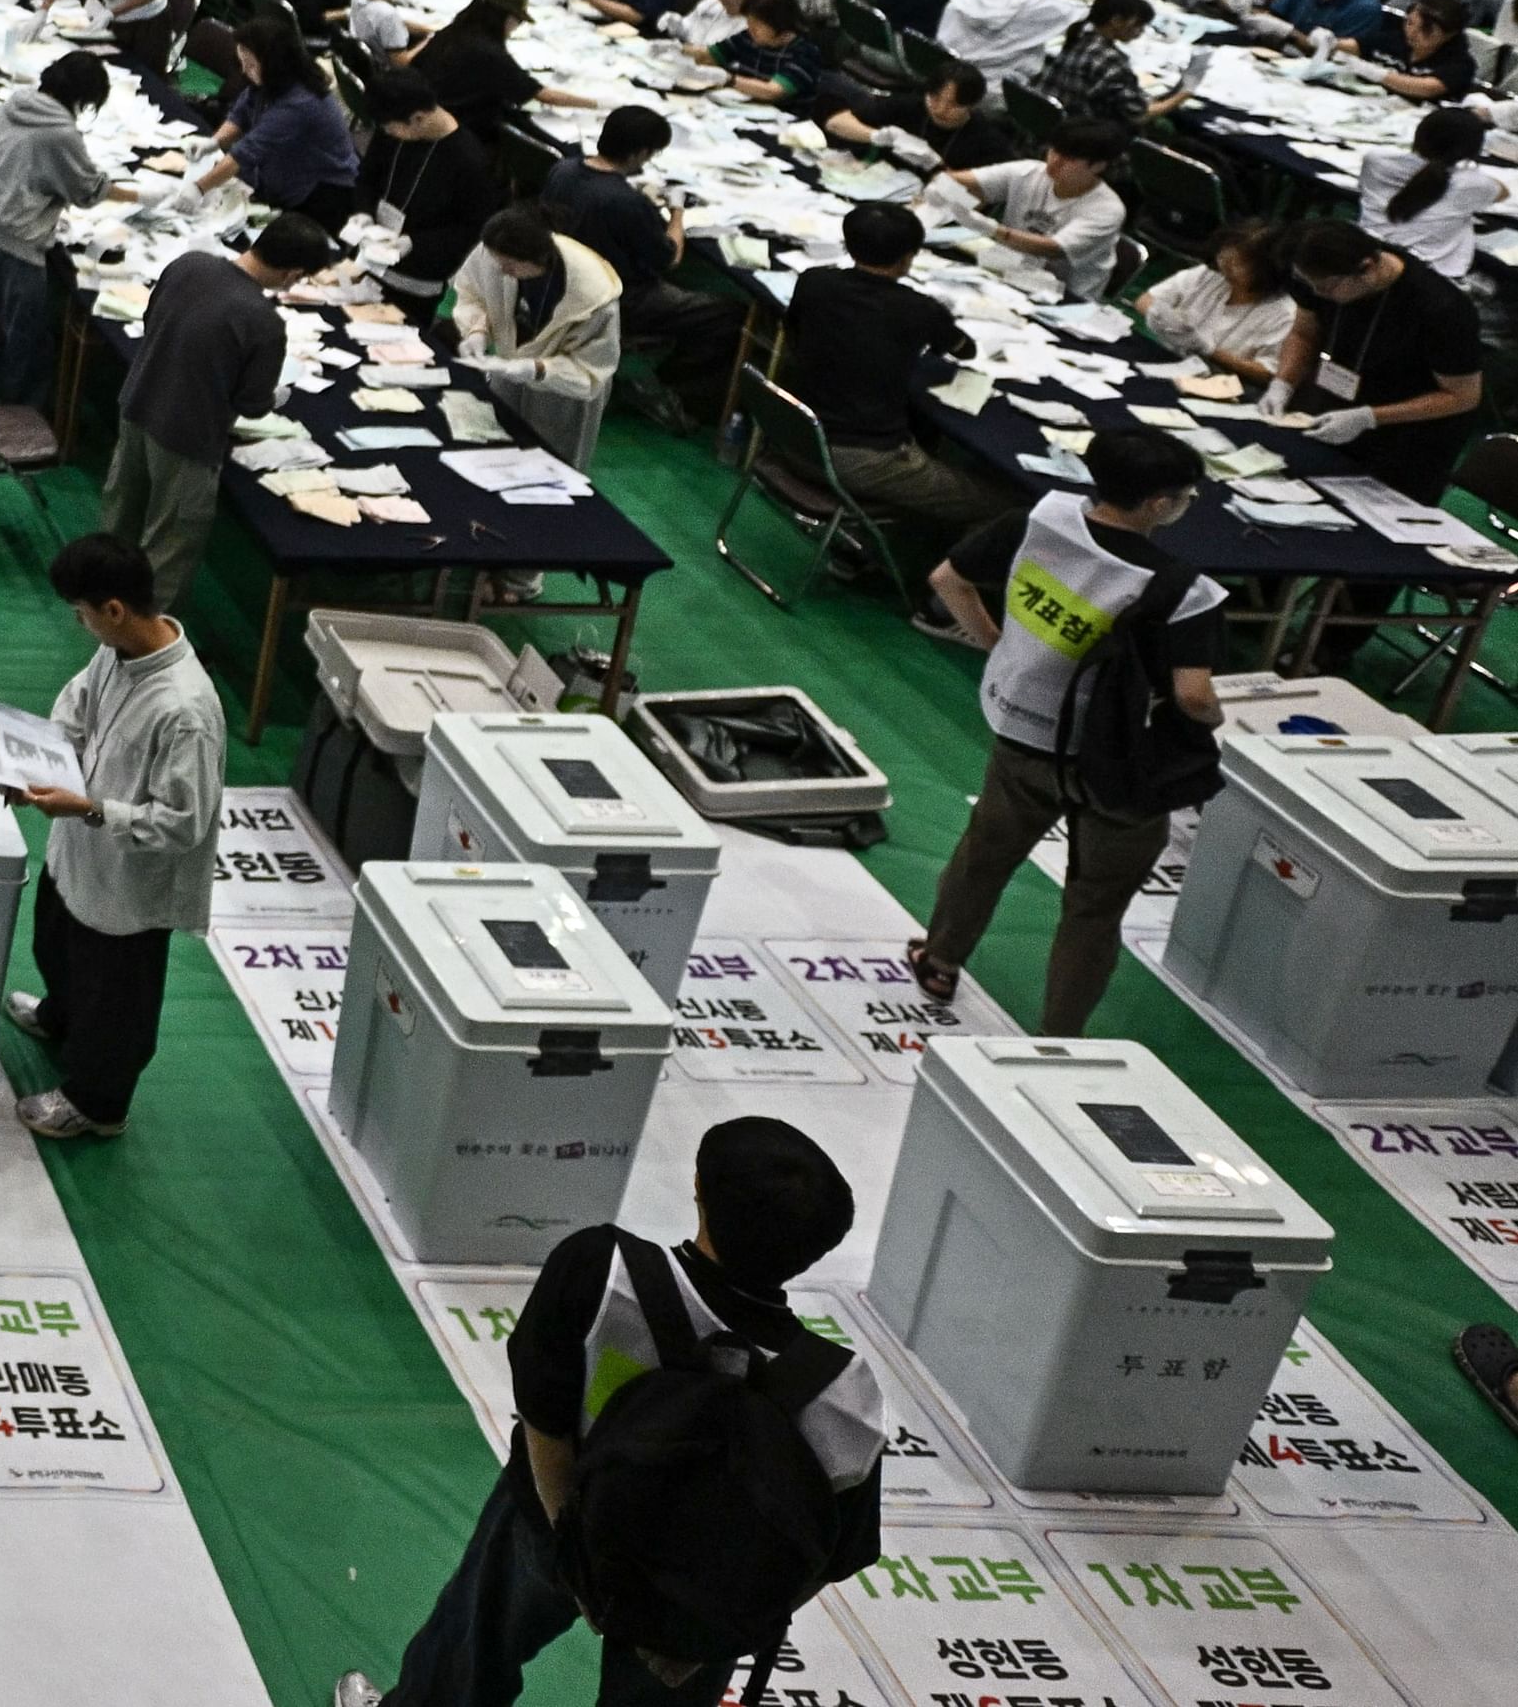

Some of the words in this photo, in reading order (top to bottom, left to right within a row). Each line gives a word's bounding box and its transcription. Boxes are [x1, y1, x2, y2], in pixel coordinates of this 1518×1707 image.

[233, 944, 304, 970] 2차
[307, 945, 347, 970] 교
[687, 954, 757, 982] 교부
[789, 955, 865, 983] 2차
[674, 997, 768, 1023] 신사동
[864, 1000, 962, 1027] 신사동
[673, 1027, 824, 1053] 제3투표소
[1349, 1123, 1441, 1156] 2차
[1446, 1181, 1518, 1209] 서림
[1256, 1392, 1340, 1427] 현동
[1237, 1434, 1422, 1474] 제4투표소
[854, 1555, 939, 1603] 1차
[929, 1556, 1046, 1605] 교부
[1087, 1561, 1195, 1611] 1차
[1180, 1564, 1302, 1614] 교부
[936, 1638, 1069, 1681] 성현동
[1197, 1644, 1333, 1691] 성현동
